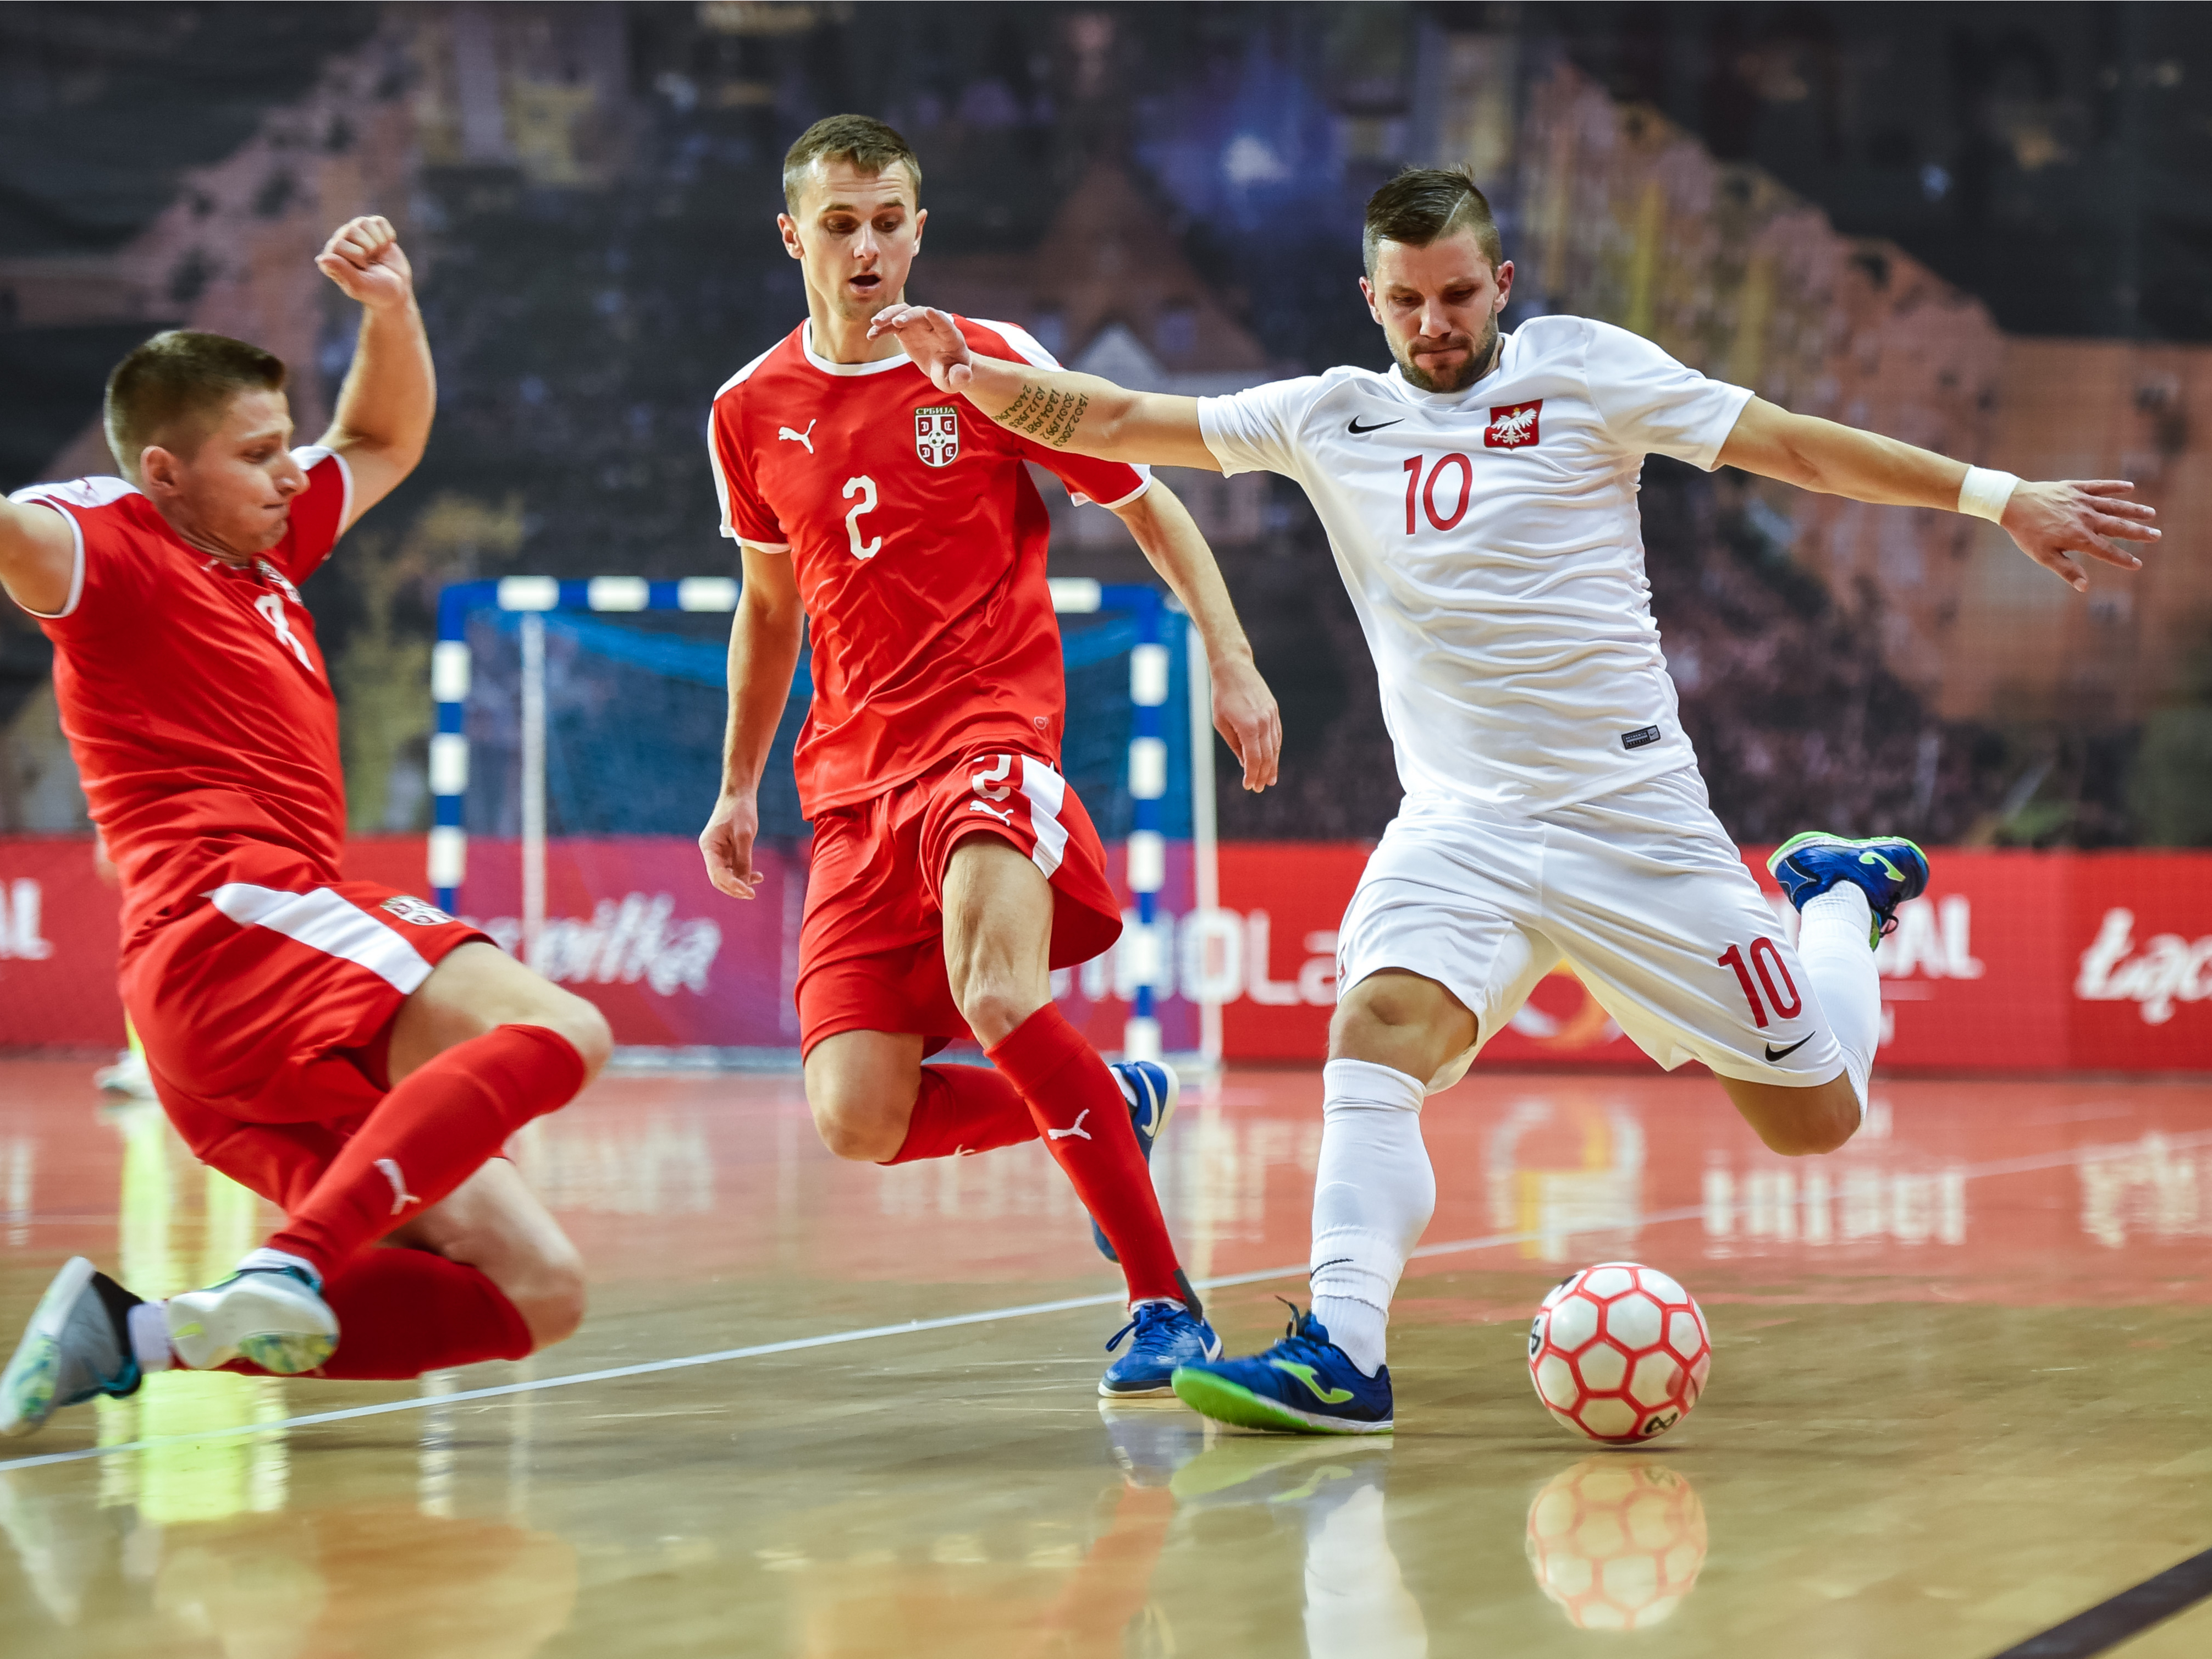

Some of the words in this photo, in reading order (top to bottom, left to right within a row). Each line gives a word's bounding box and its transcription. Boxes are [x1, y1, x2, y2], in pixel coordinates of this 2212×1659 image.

[915, 407, 956, 415] СРБИЈА
[842, 475, 882, 560] 2
[1404, 453, 1472, 535] 10
[972, 754, 1012, 802] 2
[1717, 936, 1802, 1028] 10
